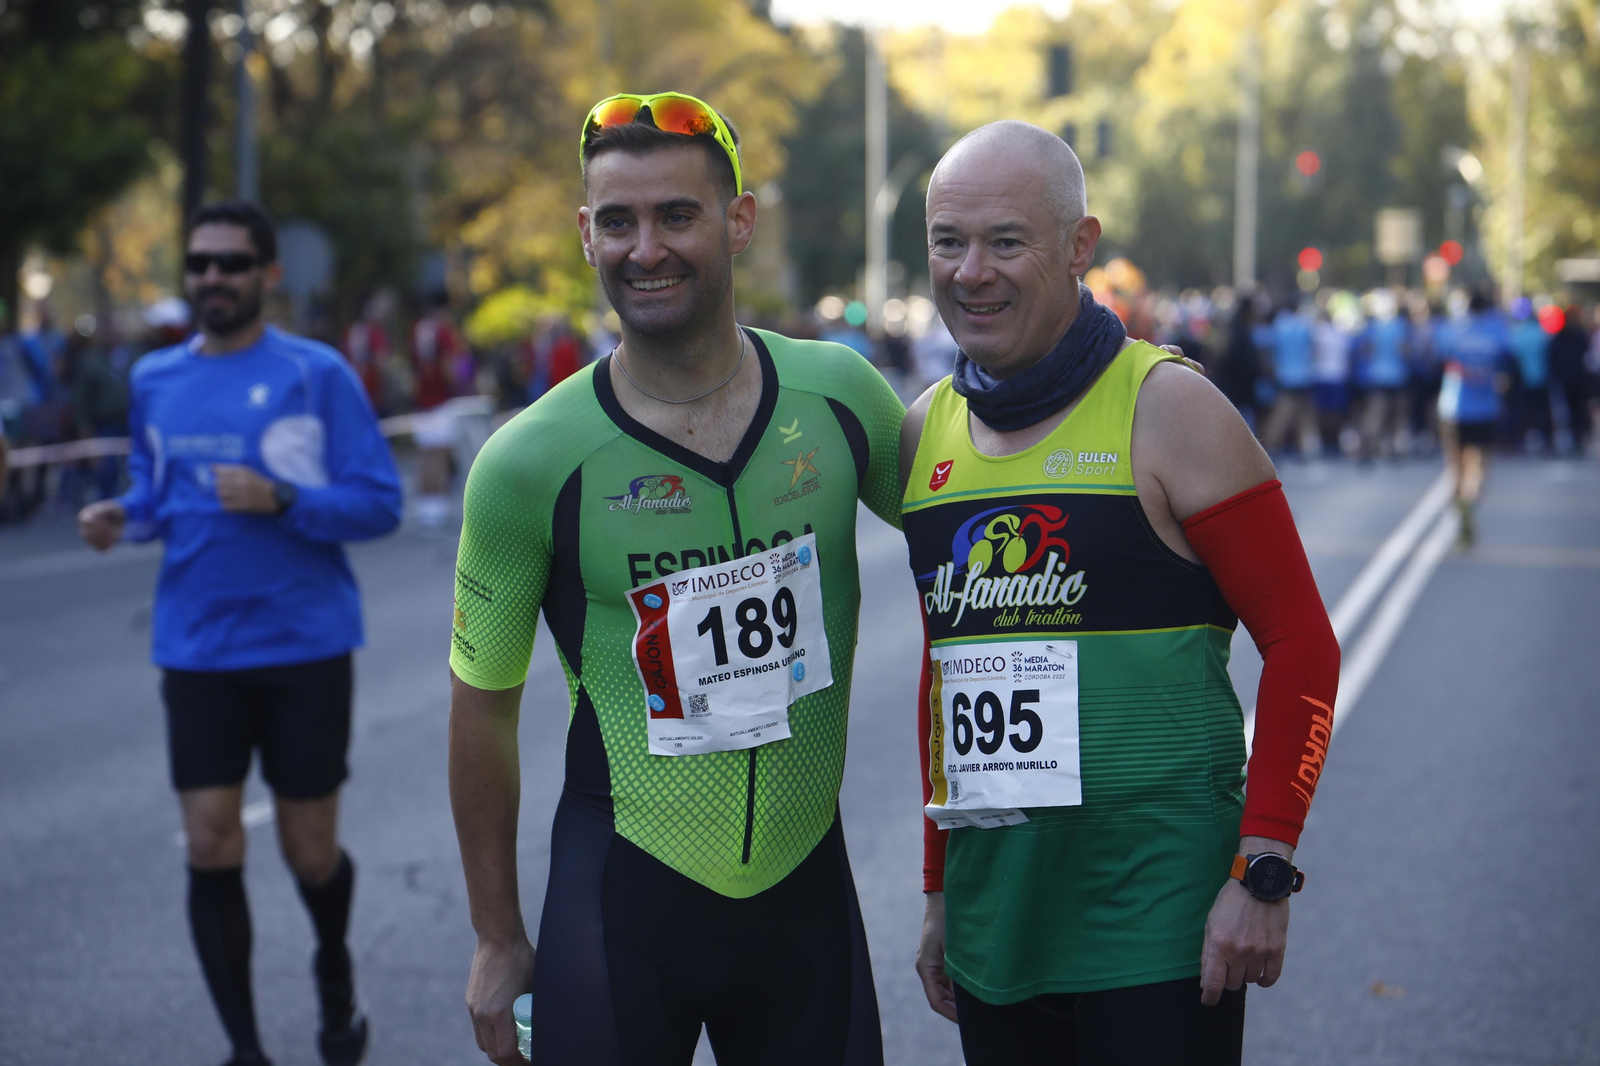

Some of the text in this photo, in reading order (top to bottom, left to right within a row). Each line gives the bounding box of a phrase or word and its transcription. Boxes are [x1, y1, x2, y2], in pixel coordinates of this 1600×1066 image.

[1077, 452, 1118, 463] EULEN
[1074, 463, 1116, 477] Sport
[773, 481, 821, 507] EXCELSIOR
[771, 556, 801, 574] 36 MARAT
[691, 562, 766, 593] IMDECO
[697, 586, 797, 666] 189
[993, 607, 1021, 628] club
[644, 634, 668, 689] CAJÓN
[949, 656, 1006, 675] IMDECO
[1012, 662, 1065, 673] 36 MARATÓN
[1024, 656, 1049, 664] MEDIA
[698, 672, 731, 687] MATEO
[733, 661, 780, 679] ESPINOSA
[952, 689, 1043, 756] 695
[933, 713, 942, 774] CAJÓN
[958, 763, 981, 773] JAVIER
[982, 761, 1014, 772] ARROYO
[1016, 760, 1058, 770] MURILLO
